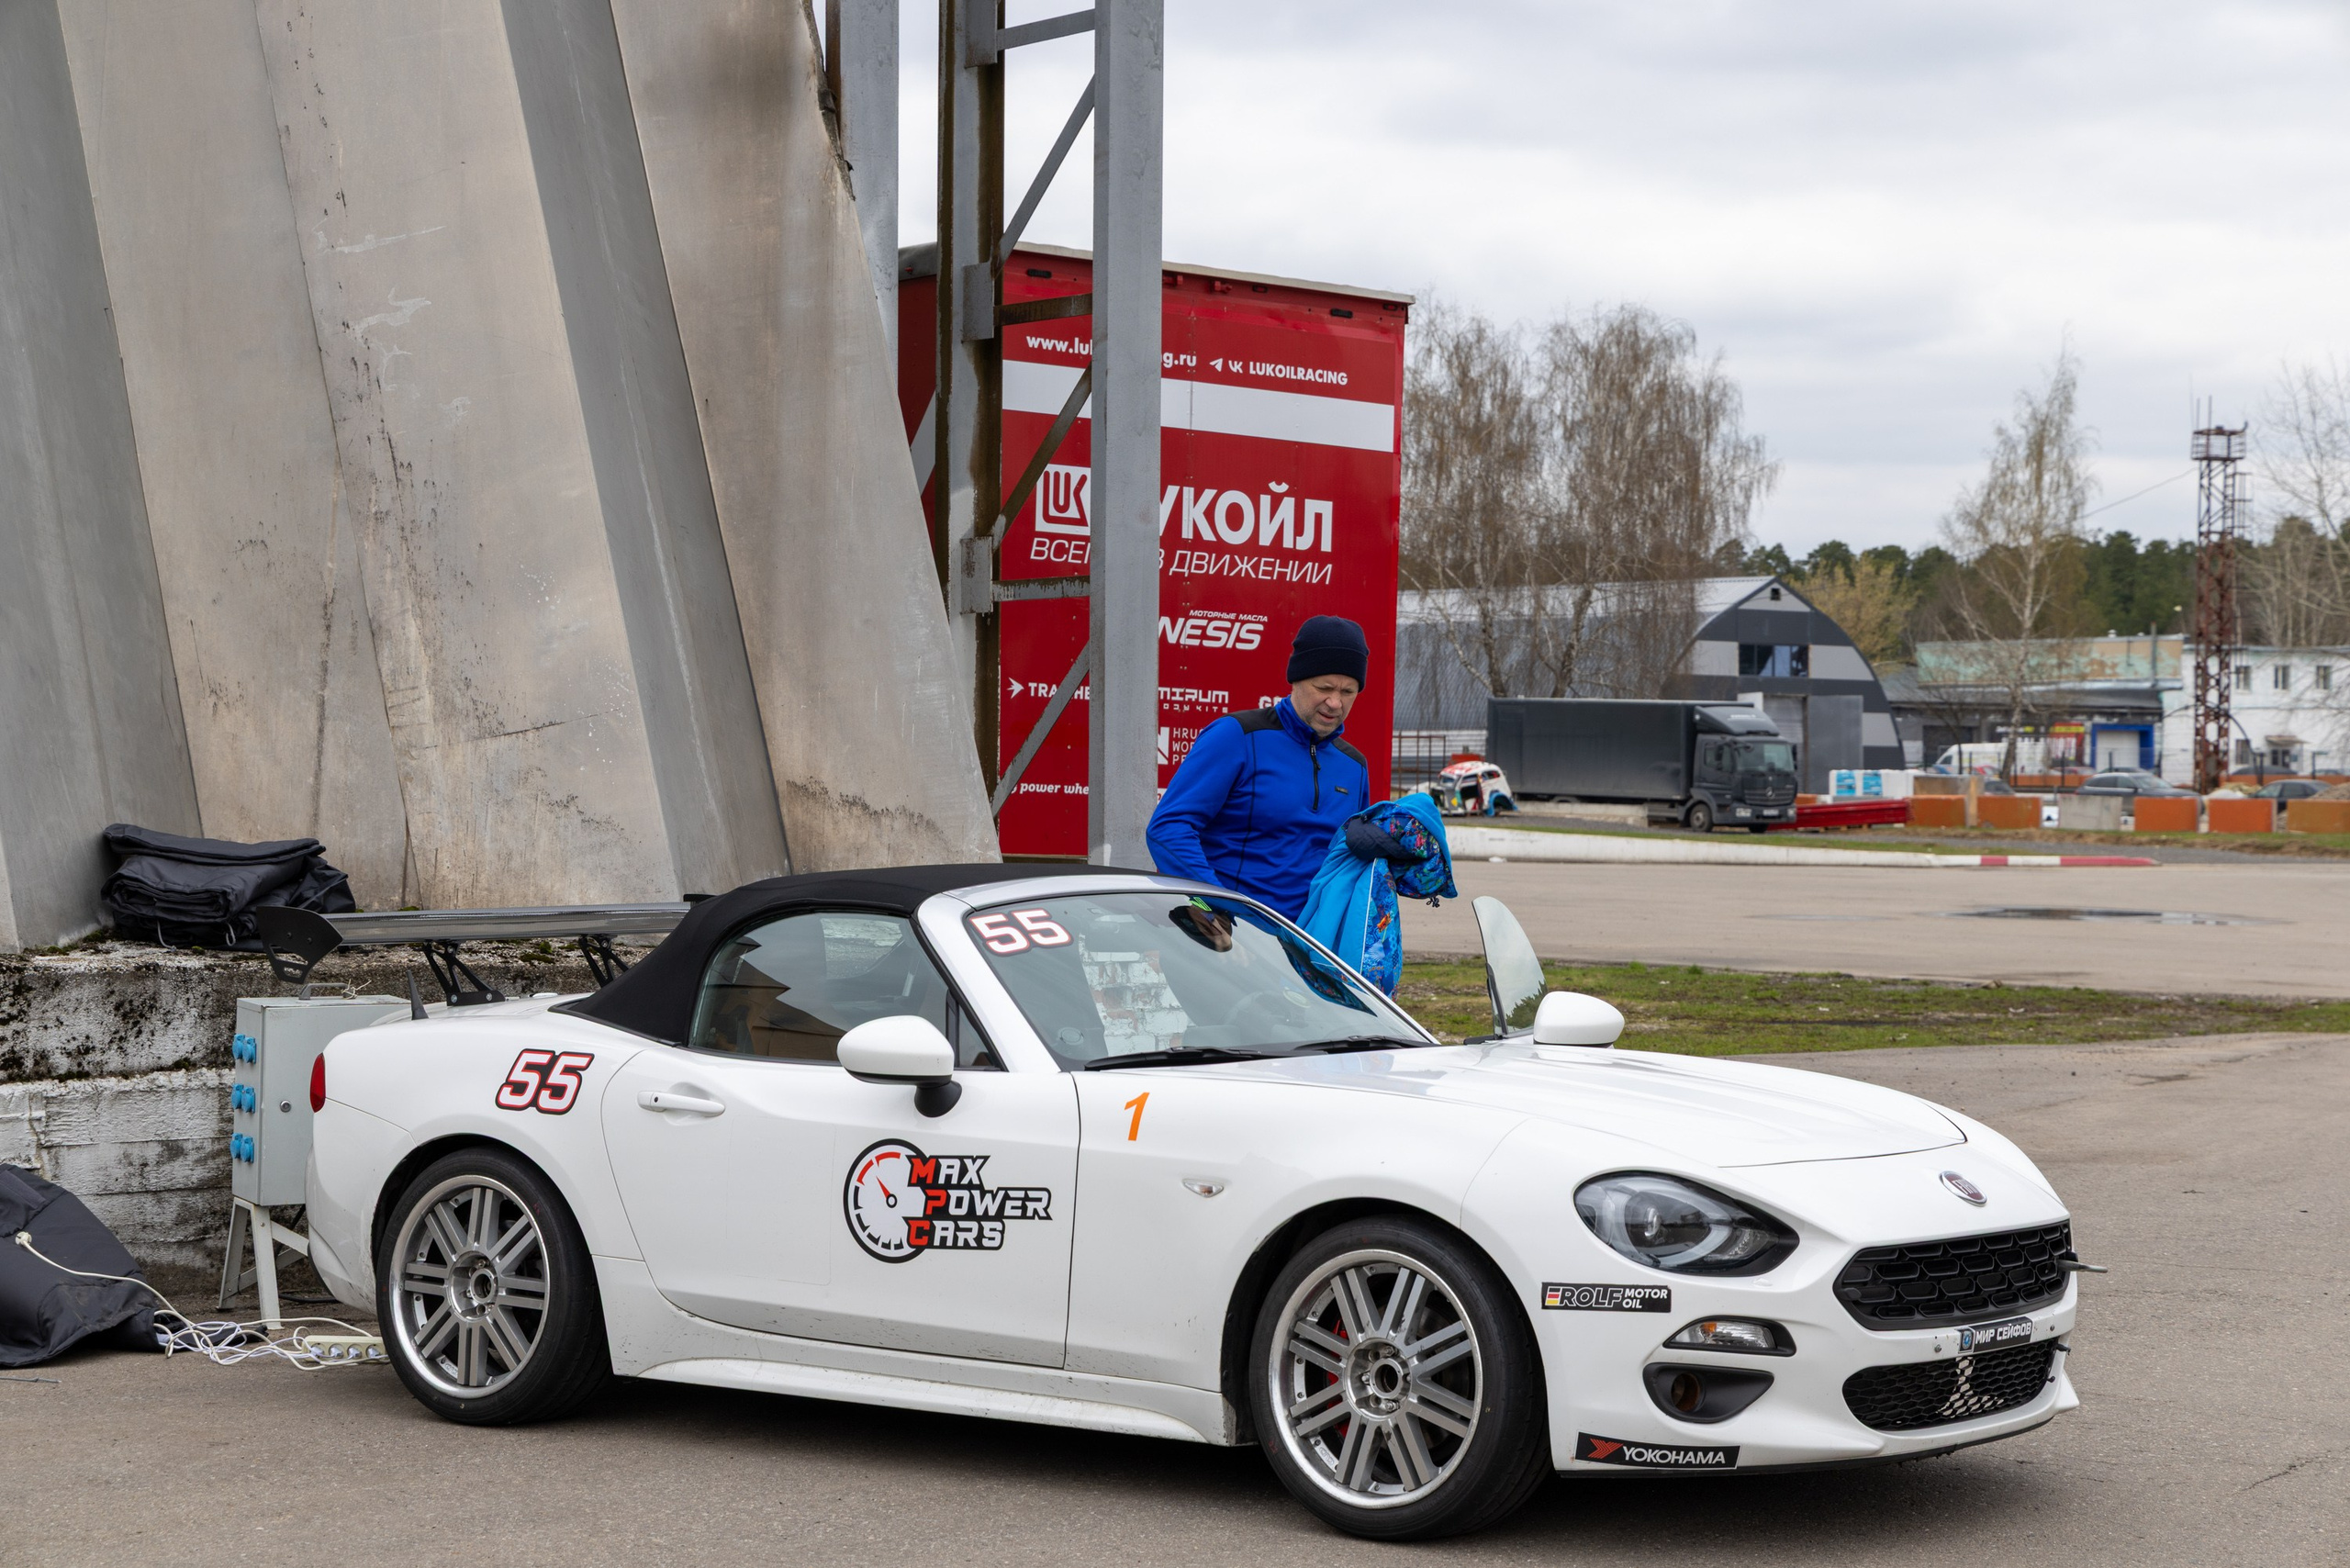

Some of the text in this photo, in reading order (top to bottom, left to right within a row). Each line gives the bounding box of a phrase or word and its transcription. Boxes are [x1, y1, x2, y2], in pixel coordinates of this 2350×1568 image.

[1249, 361, 1348, 386] LUKOILRACING
[1159, 480, 1333, 553] УКОЙЛ
[1169, 550, 1333, 585] ДВИЖЕНИИ
[1189, 610, 1269, 622] МОТОРНЫЕ МАСЛА
[1158, 616, 1264, 650] NESIS
[1019, 782, 1061, 794] power
[969, 907, 1073, 954] 55
[496, 1049, 594, 1114] 55
[1125, 1092, 1150, 1141] 1
[911, 1158, 986, 1184] MAX
[924, 1189, 1049, 1217] POWER
[907, 1219, 1004, 1248] CARS
[1558, 1286, 1623, 1307] ROLF
[1622, 1299, 1642, 1309] OIL
[1624, 1288, 1668, 1299] MOTOR
[1975, 1322, 2032, 1344] МИР СЕЙФОВ
[1623, 1446, 1726, 1464] YOKOHAMA
